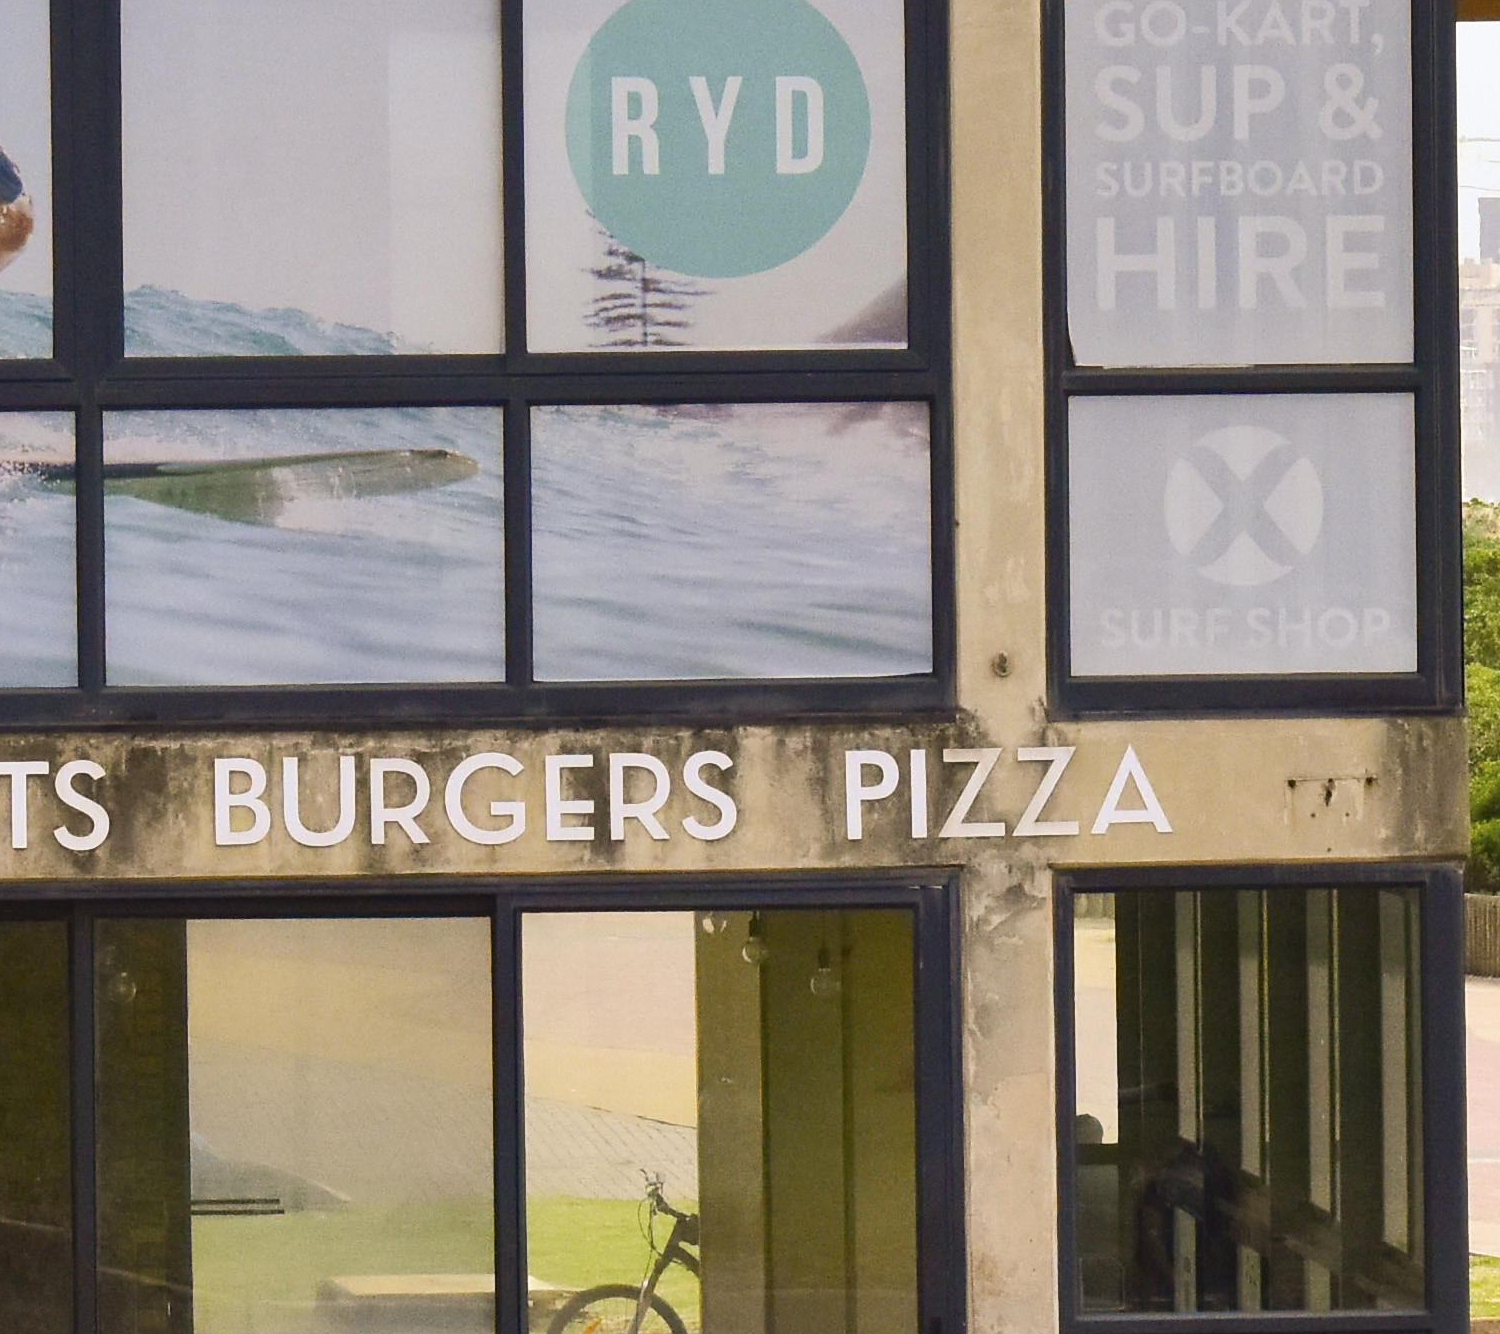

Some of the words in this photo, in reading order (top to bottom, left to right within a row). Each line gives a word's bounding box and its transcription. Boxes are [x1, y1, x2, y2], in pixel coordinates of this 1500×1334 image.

[611, 75, 825, 176] RYD
[1095, 64, 1286, 141] SUP
[1318, 63, 1384, 140] &
[1098, 160, 1384, 198] SURFBOARD
[1096, 214, 1387, 309] HIRE
[1100, 608, 1231, 649] SURF
[1247, 607, 1390, 648] SHOP
[213, 750, 738, 846] BURGERS
[844, 744, 1173, 840] PIZZA
